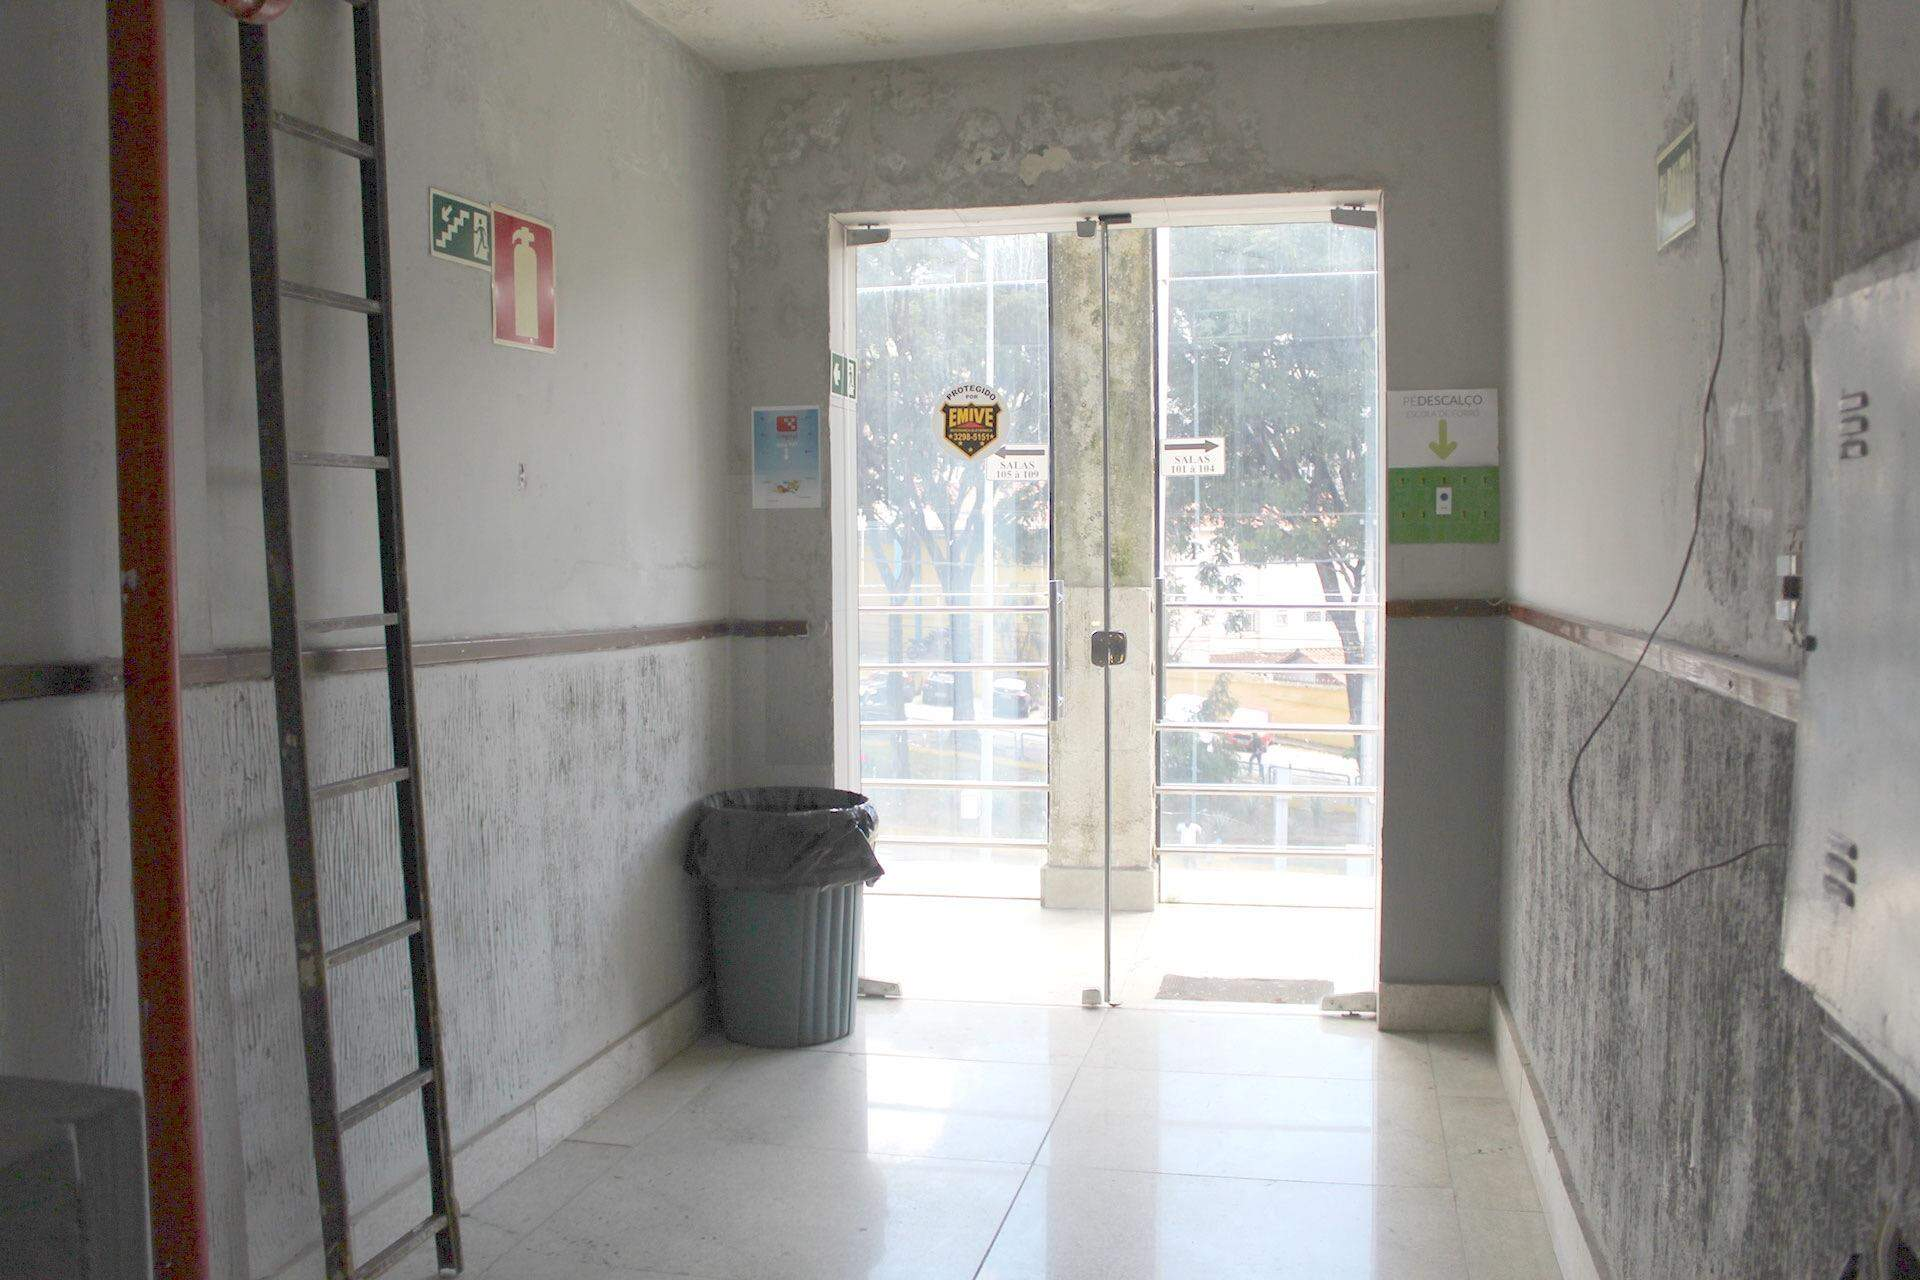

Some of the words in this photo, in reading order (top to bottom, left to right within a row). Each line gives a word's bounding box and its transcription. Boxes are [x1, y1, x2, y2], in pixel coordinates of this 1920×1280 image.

[946, 385, 997, 401] PROTEGIDO
[949, 407, 994, 428] EMIVE
[1174, 455, 1211, 464] SALAS
[1000, 461, 1035, 470] SALAS
[1171, 464, 1186, 473] 101
[1199, 464, 1215, 473] 104
[997, 470, 1012, 479] 105
[1024, 470, 1040, 479] 109
